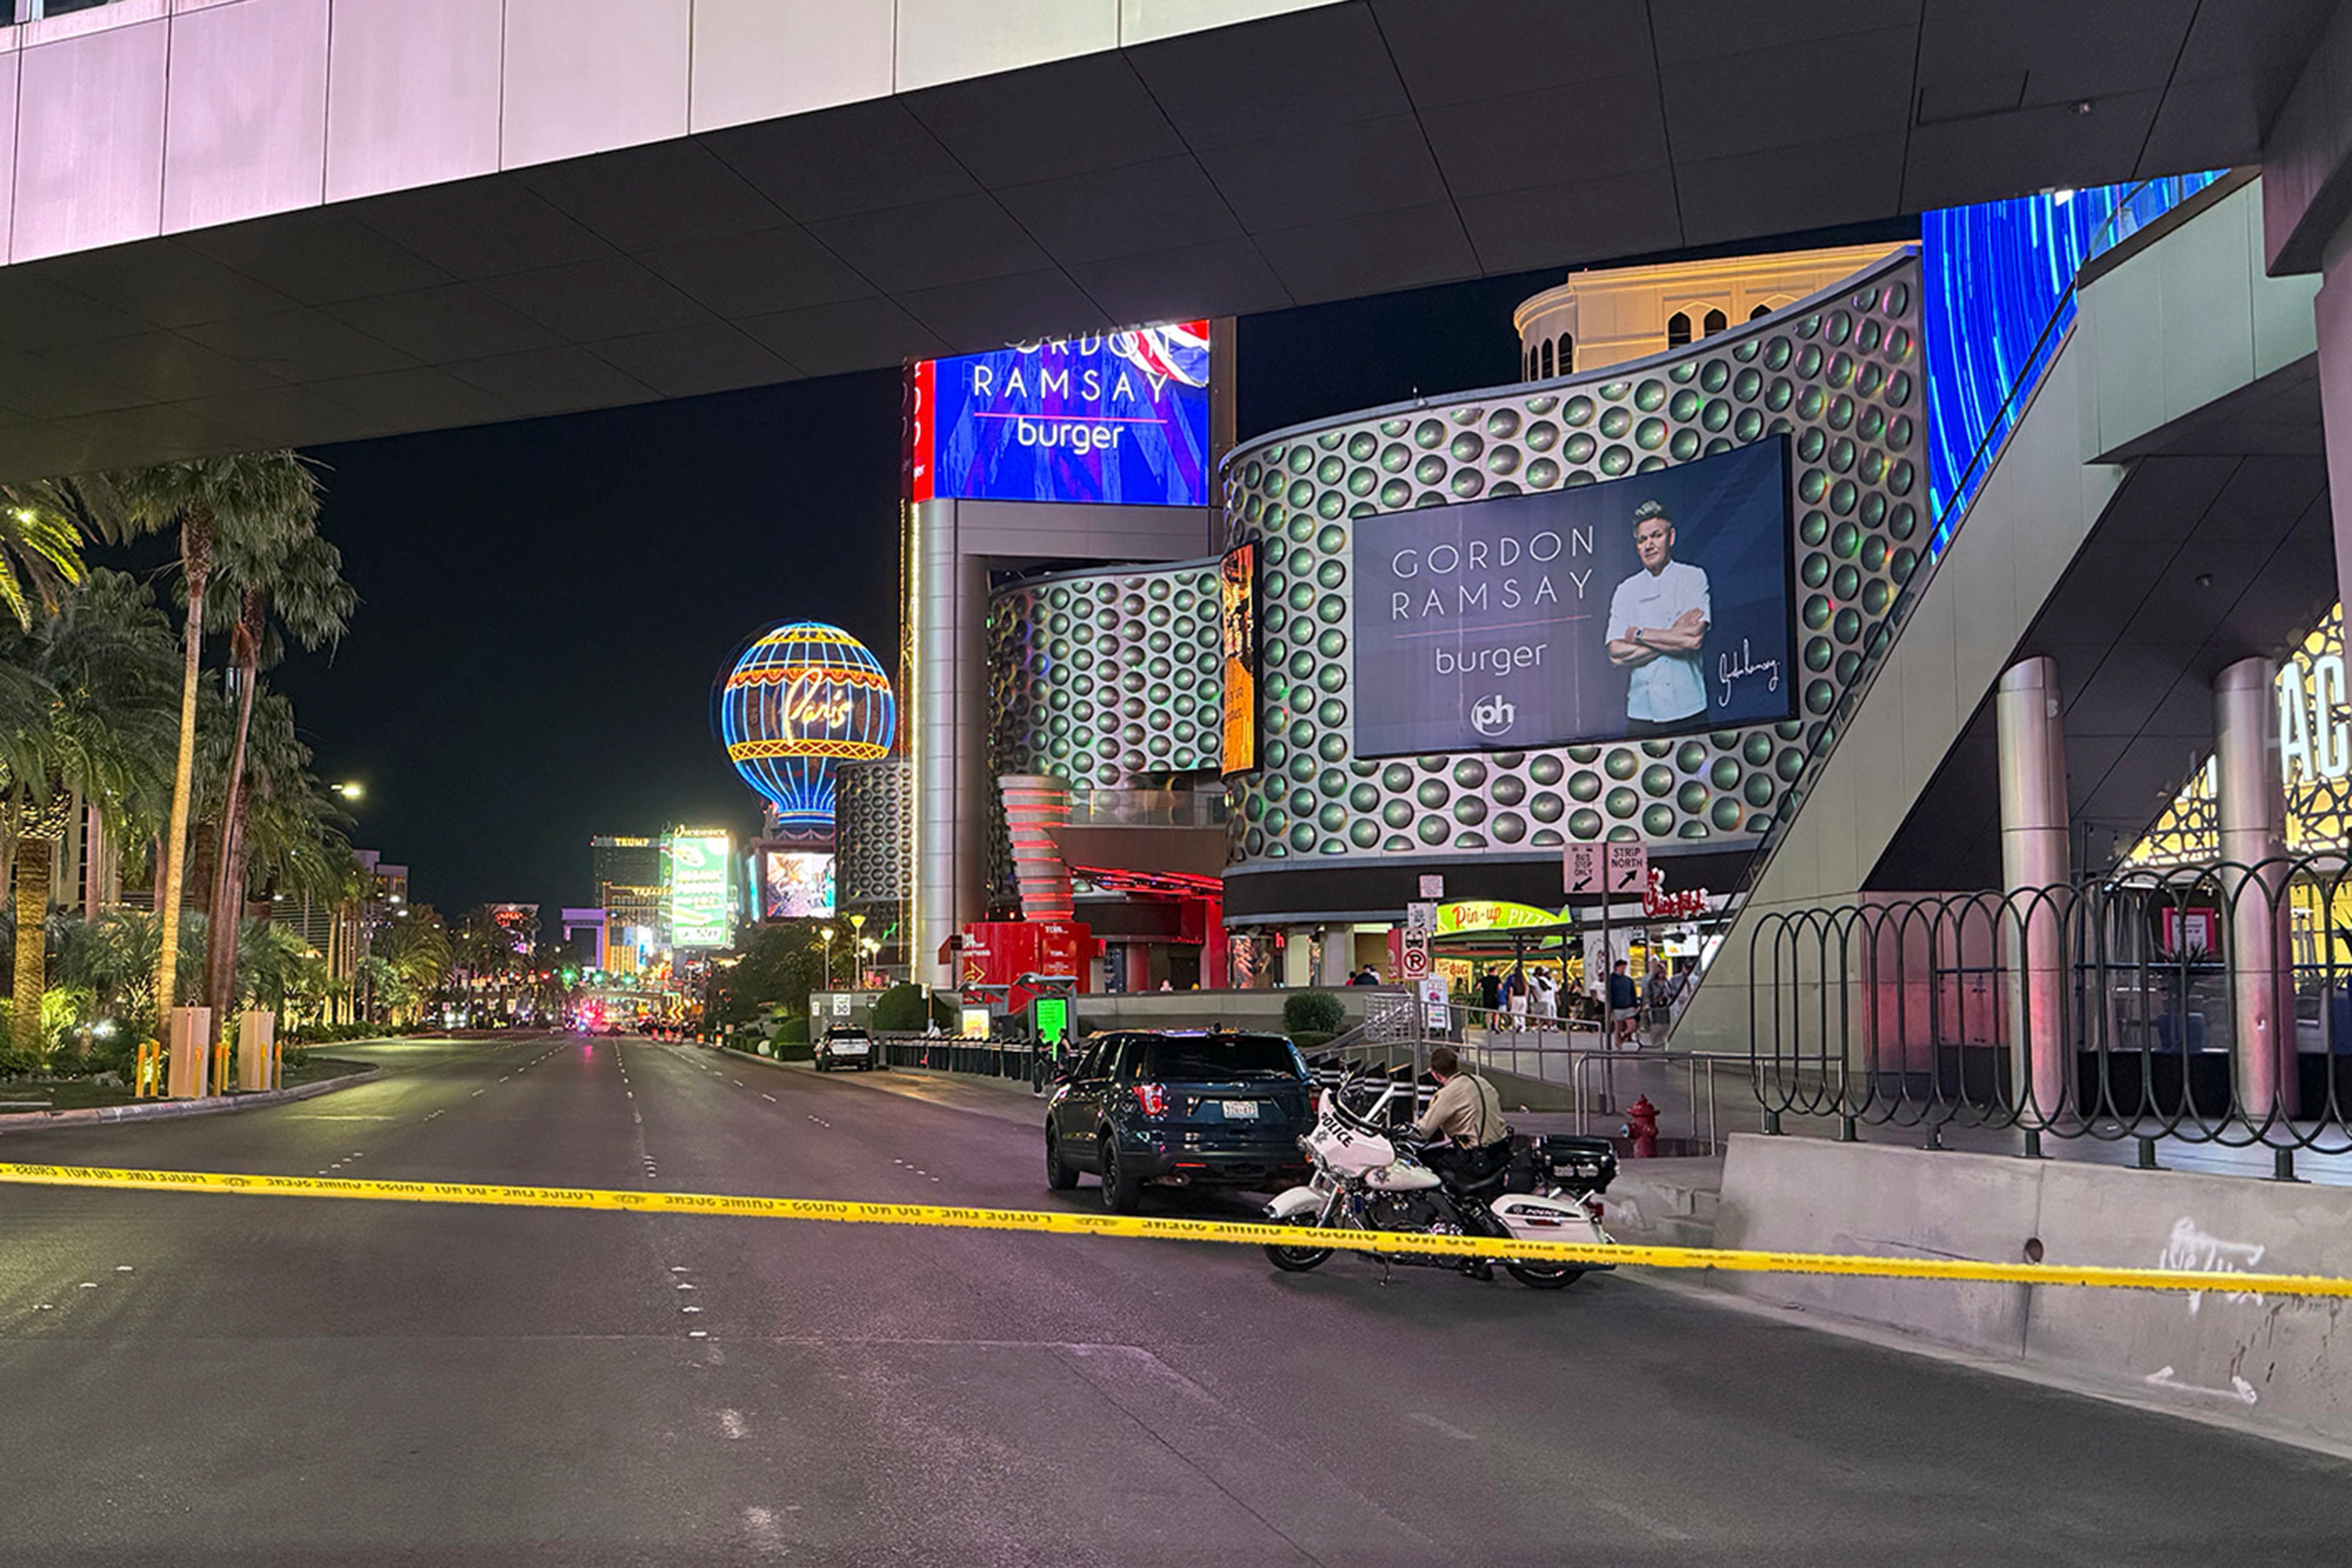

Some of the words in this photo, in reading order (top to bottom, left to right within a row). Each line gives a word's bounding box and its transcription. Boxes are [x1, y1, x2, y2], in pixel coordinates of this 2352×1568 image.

[974, 365, 1168, 403] RAMSAY
[1018, 417, 1124, 455] burger
[1391, 525, 1594, 579] GORDON
[1391, 569, 1593, 621] RAMSAY
[1436, 643, 1548, 676] burger
[784, 667, 853, 747] Paris
[1472, 695, 1515, 734] ph
[614, 837, 650, 847] TRUMP
[1613, 847, 1641, 858] STRIP
[1611, 858, 1642, 868] NORTH
[1452, 905, 1502, 929] Pin-up
[1321, 1112, 1354, 1148] POLICE
